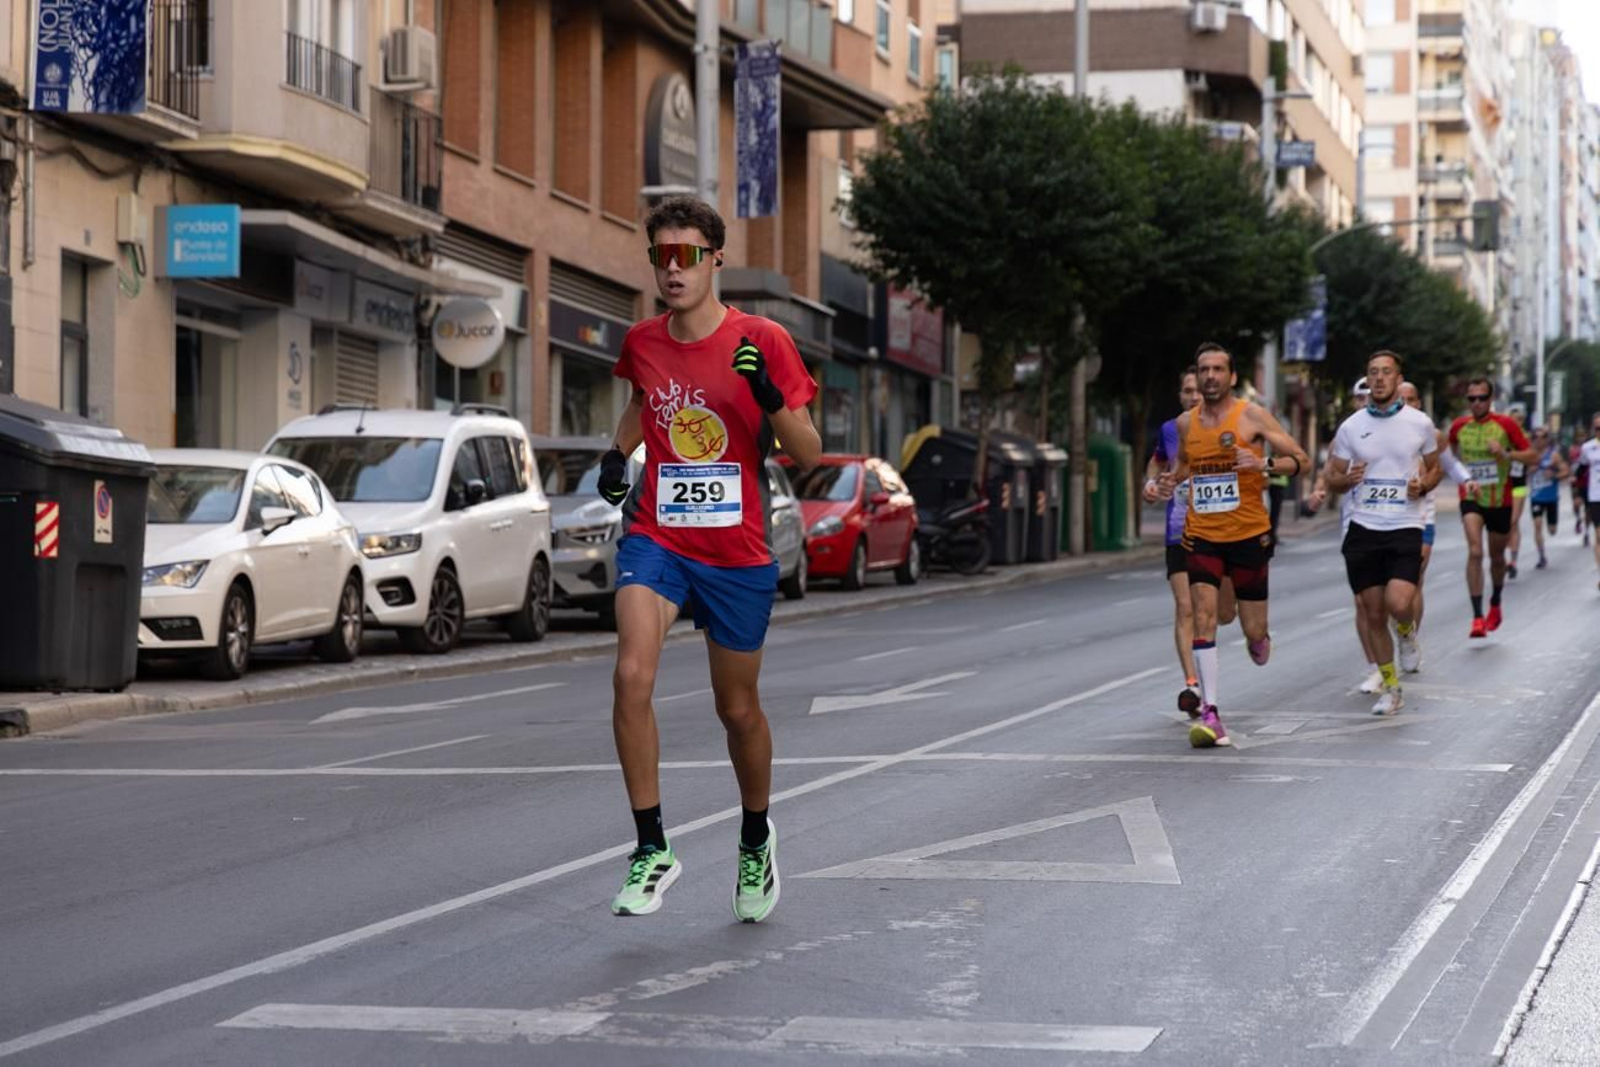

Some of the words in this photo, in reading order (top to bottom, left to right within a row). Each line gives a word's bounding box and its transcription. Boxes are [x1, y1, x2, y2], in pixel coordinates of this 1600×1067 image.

[59, 11, 73, 53] JUAN
[649, 378, 682, 411] Club
[672, 481, 725, 503] 259
[1196, 484, 1235, 499] 1014
[1370, 487, 1398, 500] 242
